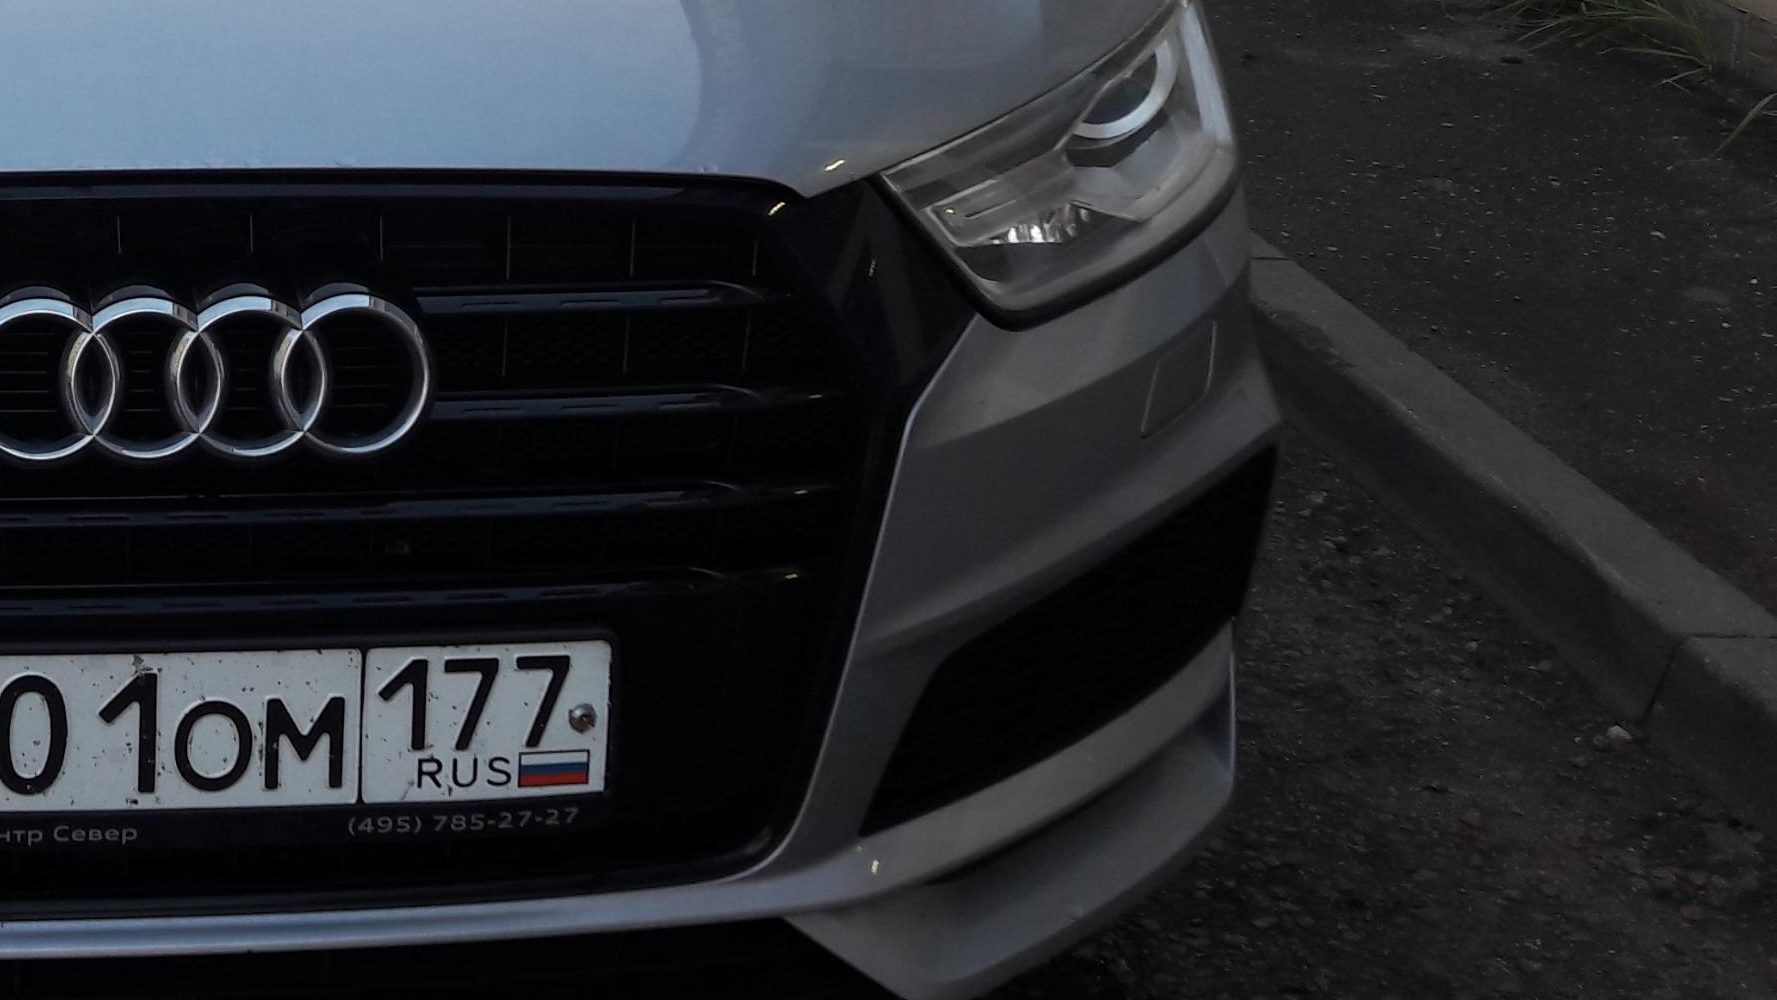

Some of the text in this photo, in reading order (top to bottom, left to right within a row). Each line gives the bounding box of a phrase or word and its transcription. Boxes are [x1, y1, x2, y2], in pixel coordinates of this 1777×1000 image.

[378, 655, 571, 751] 177
[416, 756, 512, 789] RUS
[53, 825, 138, 845] Север
[348, 807, 579, 836] (495) 785-27-27
